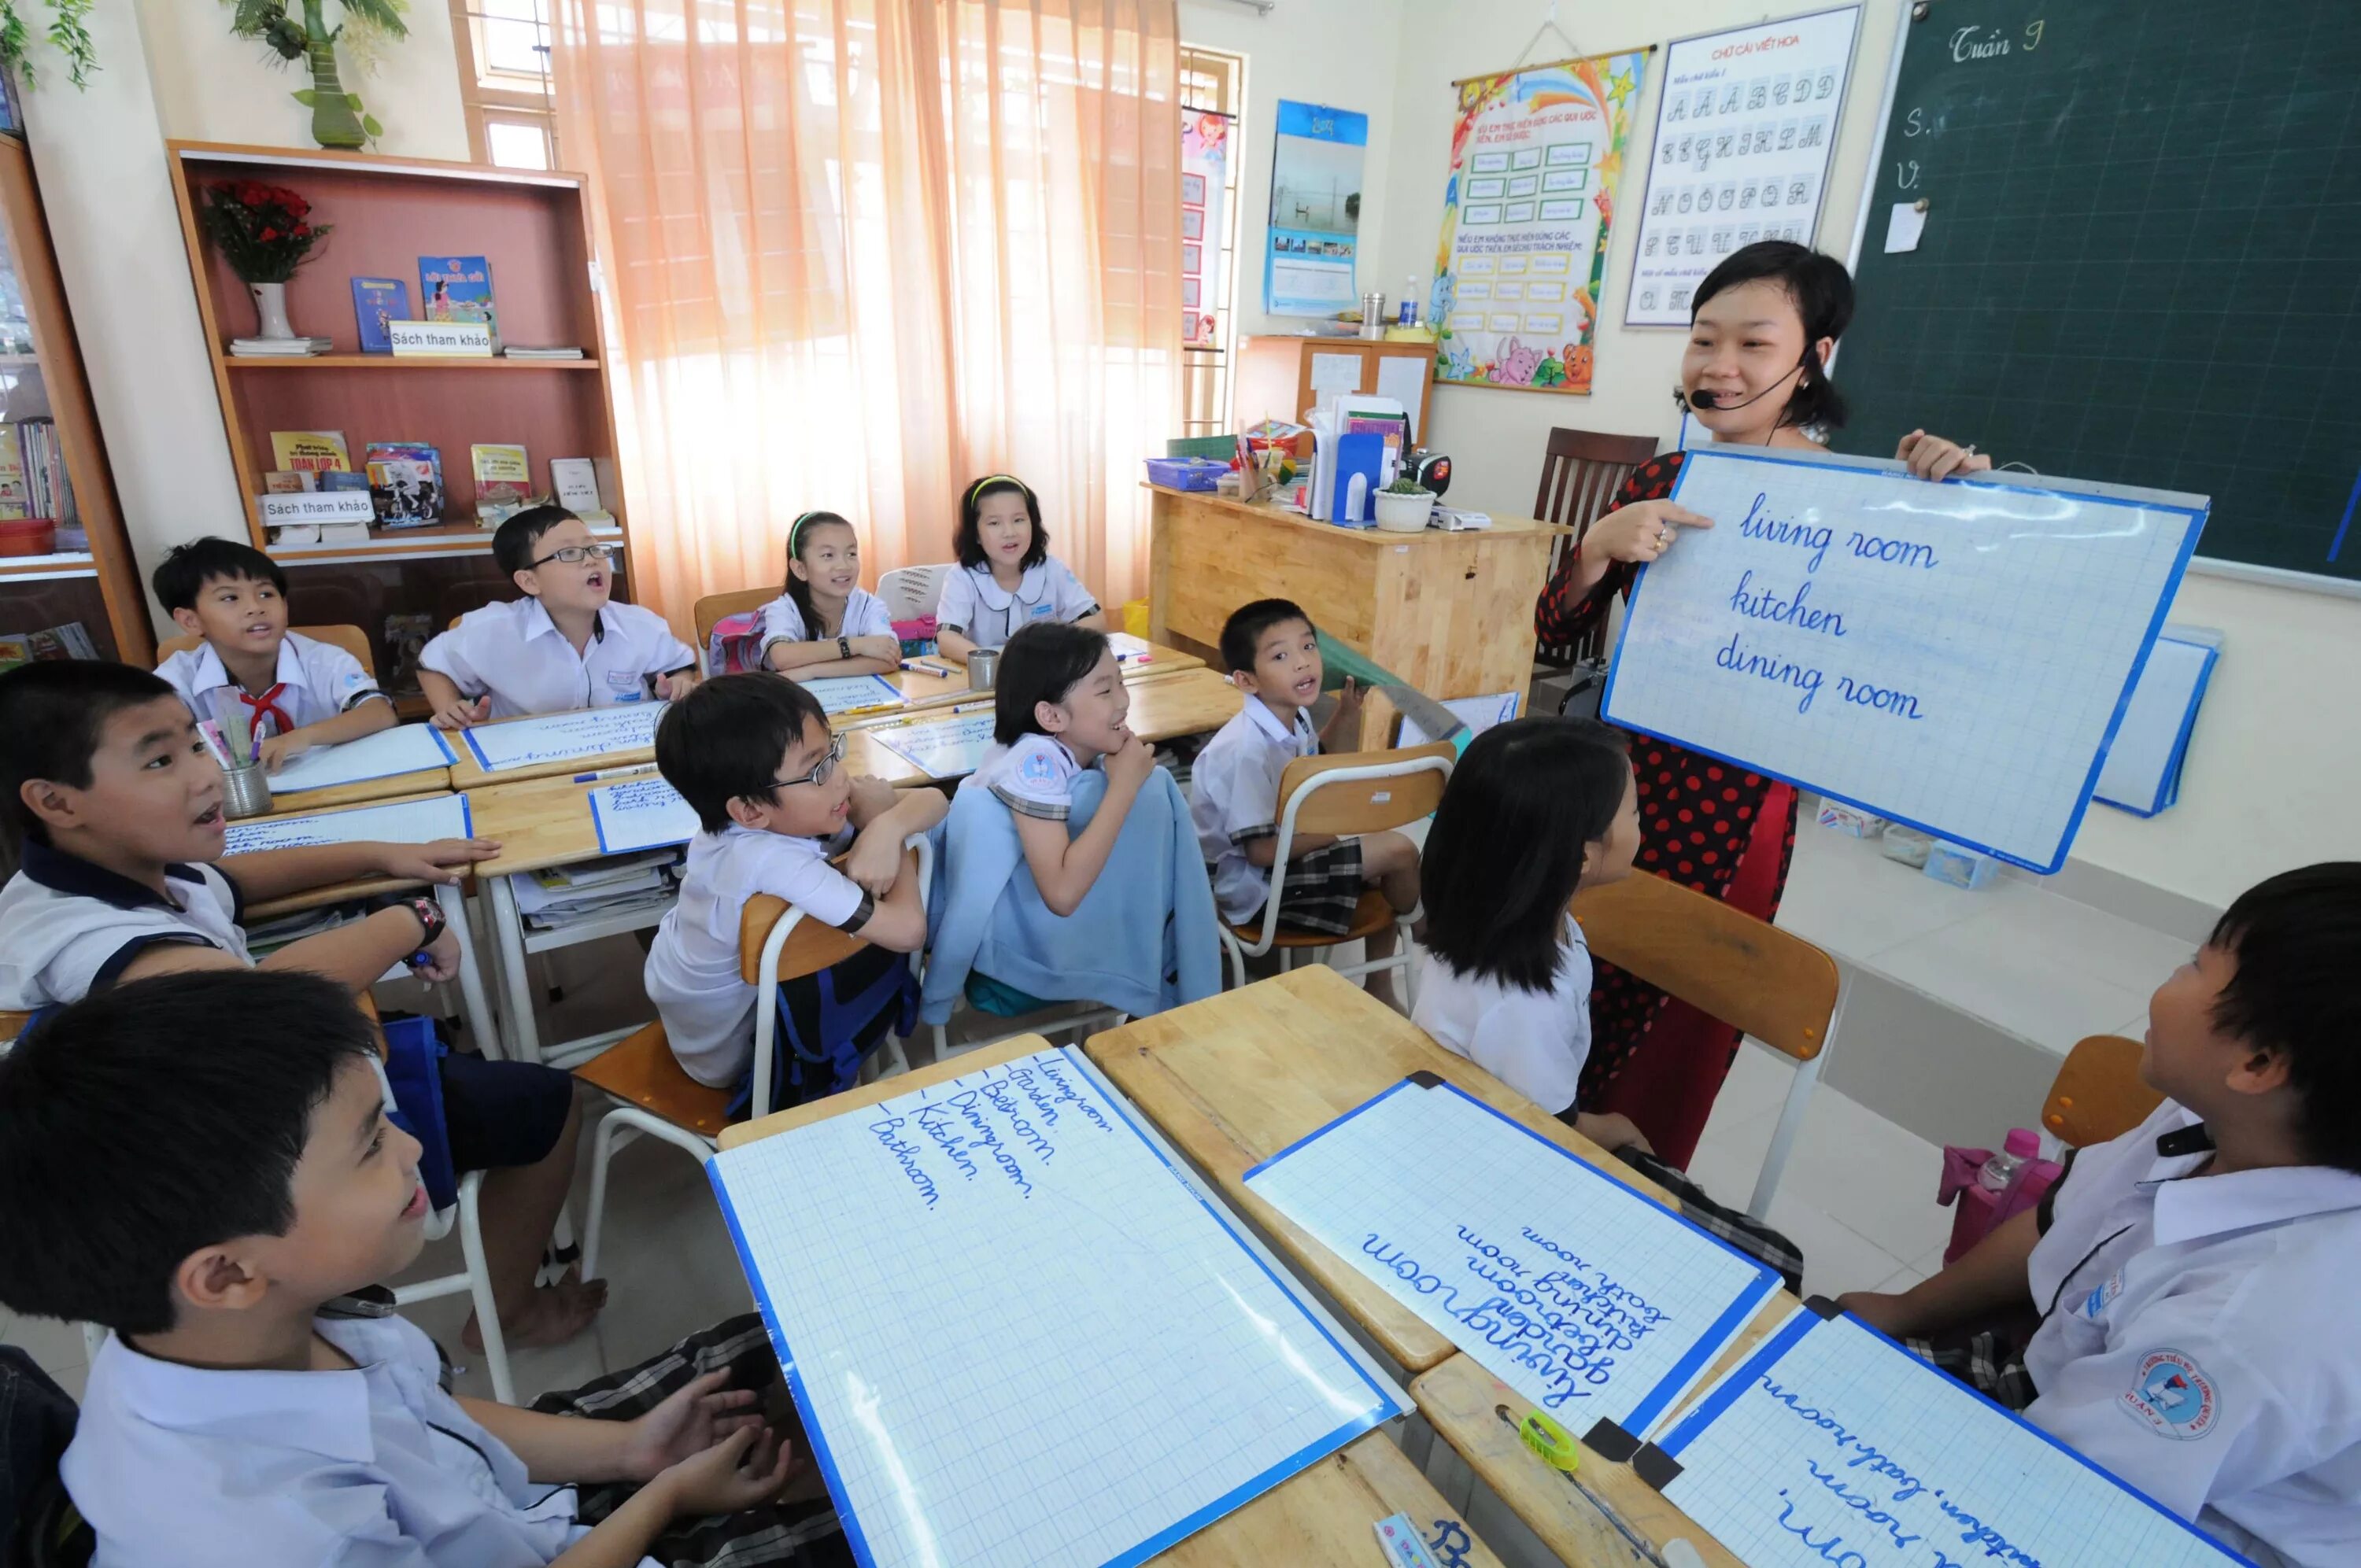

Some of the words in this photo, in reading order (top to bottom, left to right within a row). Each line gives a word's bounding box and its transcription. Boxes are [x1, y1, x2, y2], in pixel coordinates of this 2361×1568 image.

[1712, 45, 1733, 61] CHỮ
[1735, 41, 1753, 57] CÁI
[1755, 36, 1777, 53] VIẾT
[1777, 35, 1800, 49] HOA
[1949, 25, 2010, 63] Tuần
[2023, 20, 2045, 50] 9
[393, 332, 423, 345] Sách
[427, 334, 456, 346] tham
[460, 332, 489, 347] khảo
[268, 502, 300, 516] Sách
[304, 501, 334, 514] tham
[338, 498, 368, 512] khảo
[1740, 493, 1833, 574] living
[1846, 532, 1939, 569] room
[1731, 570, 1847, 636] kitchen
[1716, 633, 1825, 714] dining
[1837, 677, 1923, 719] room
[1457, 1224, 1532, 1278] room
[1520, 1226, 1592, 1271] room
[1533, 1271, 1633, 1352] dining
[1562, 1271, 1655, 1339] kitchen
[1761, 1374, 1857, 1447] room
[1847, 1442, 1928, 1502] bath
[1807, 1459, 1921, 1549] room
